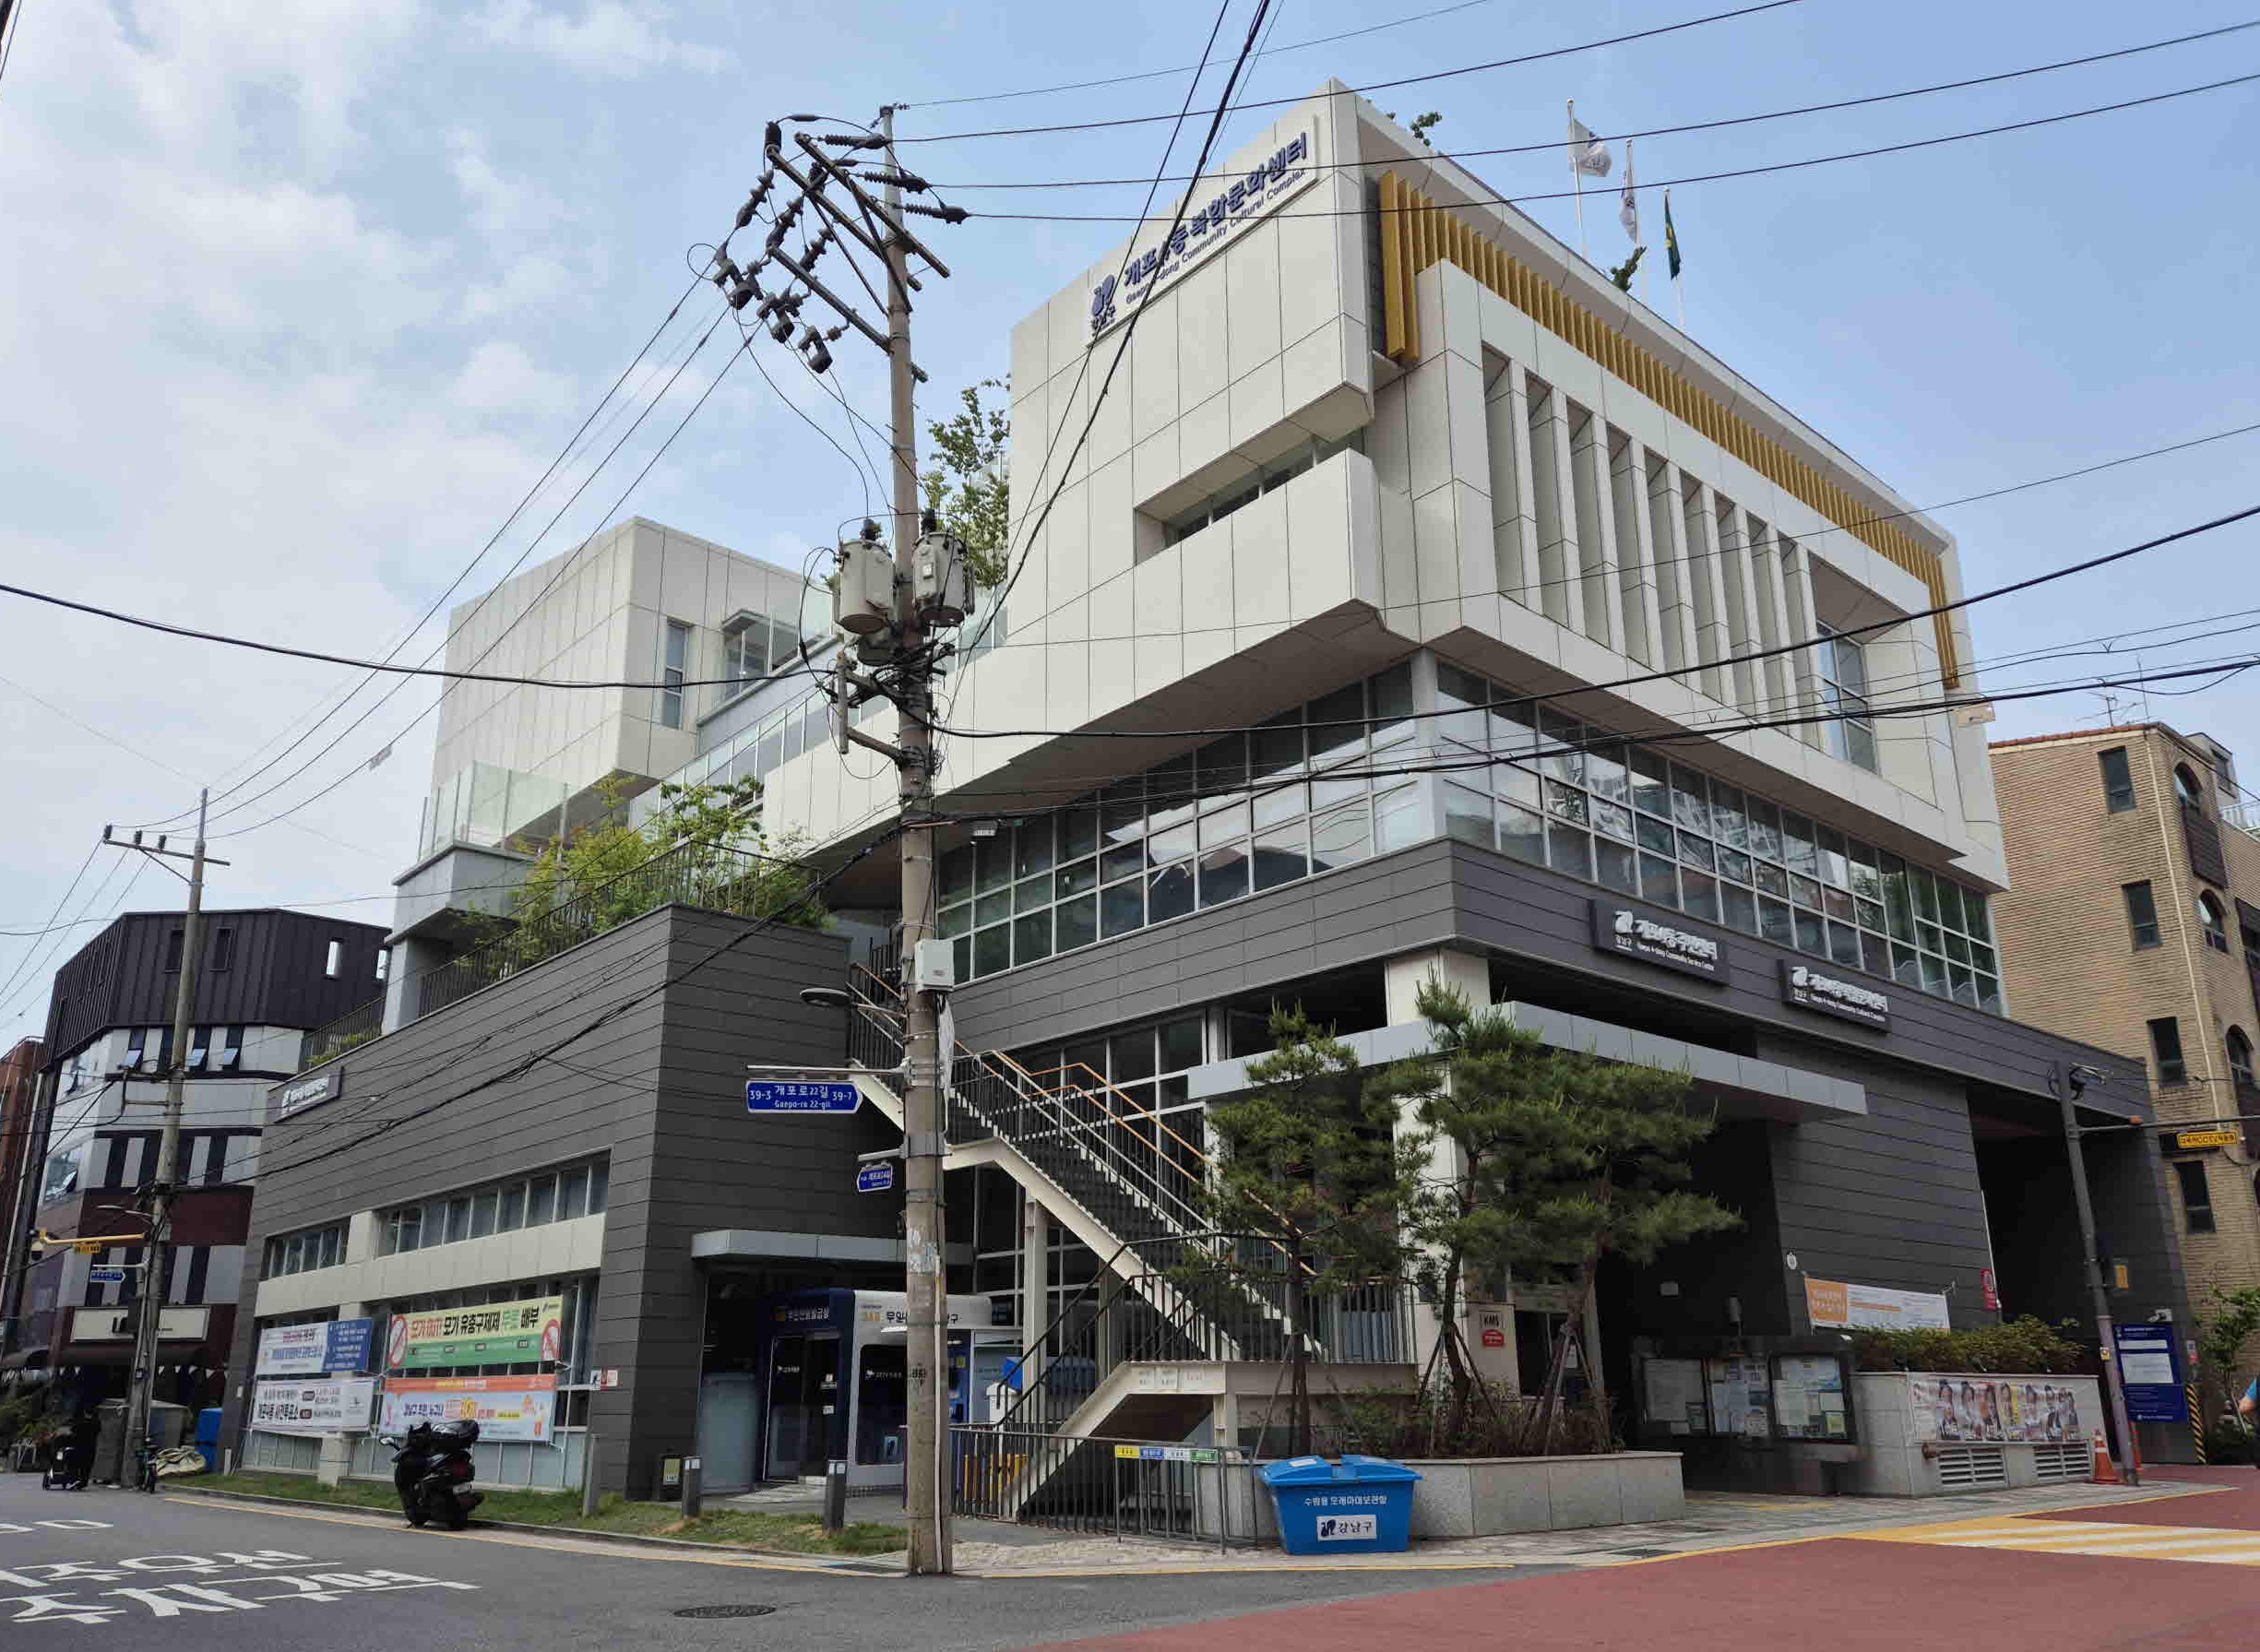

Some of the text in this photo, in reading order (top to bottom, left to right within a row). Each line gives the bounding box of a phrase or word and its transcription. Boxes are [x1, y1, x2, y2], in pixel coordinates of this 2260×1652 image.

[749, 1085, 852, 1101] 39-3 개포로22길 39-7
[444, 1315, 459, 1337] 모기
[521, 1305, 540, 1329] 배부
[1338, 1521, 1373, 1534] 강남구
